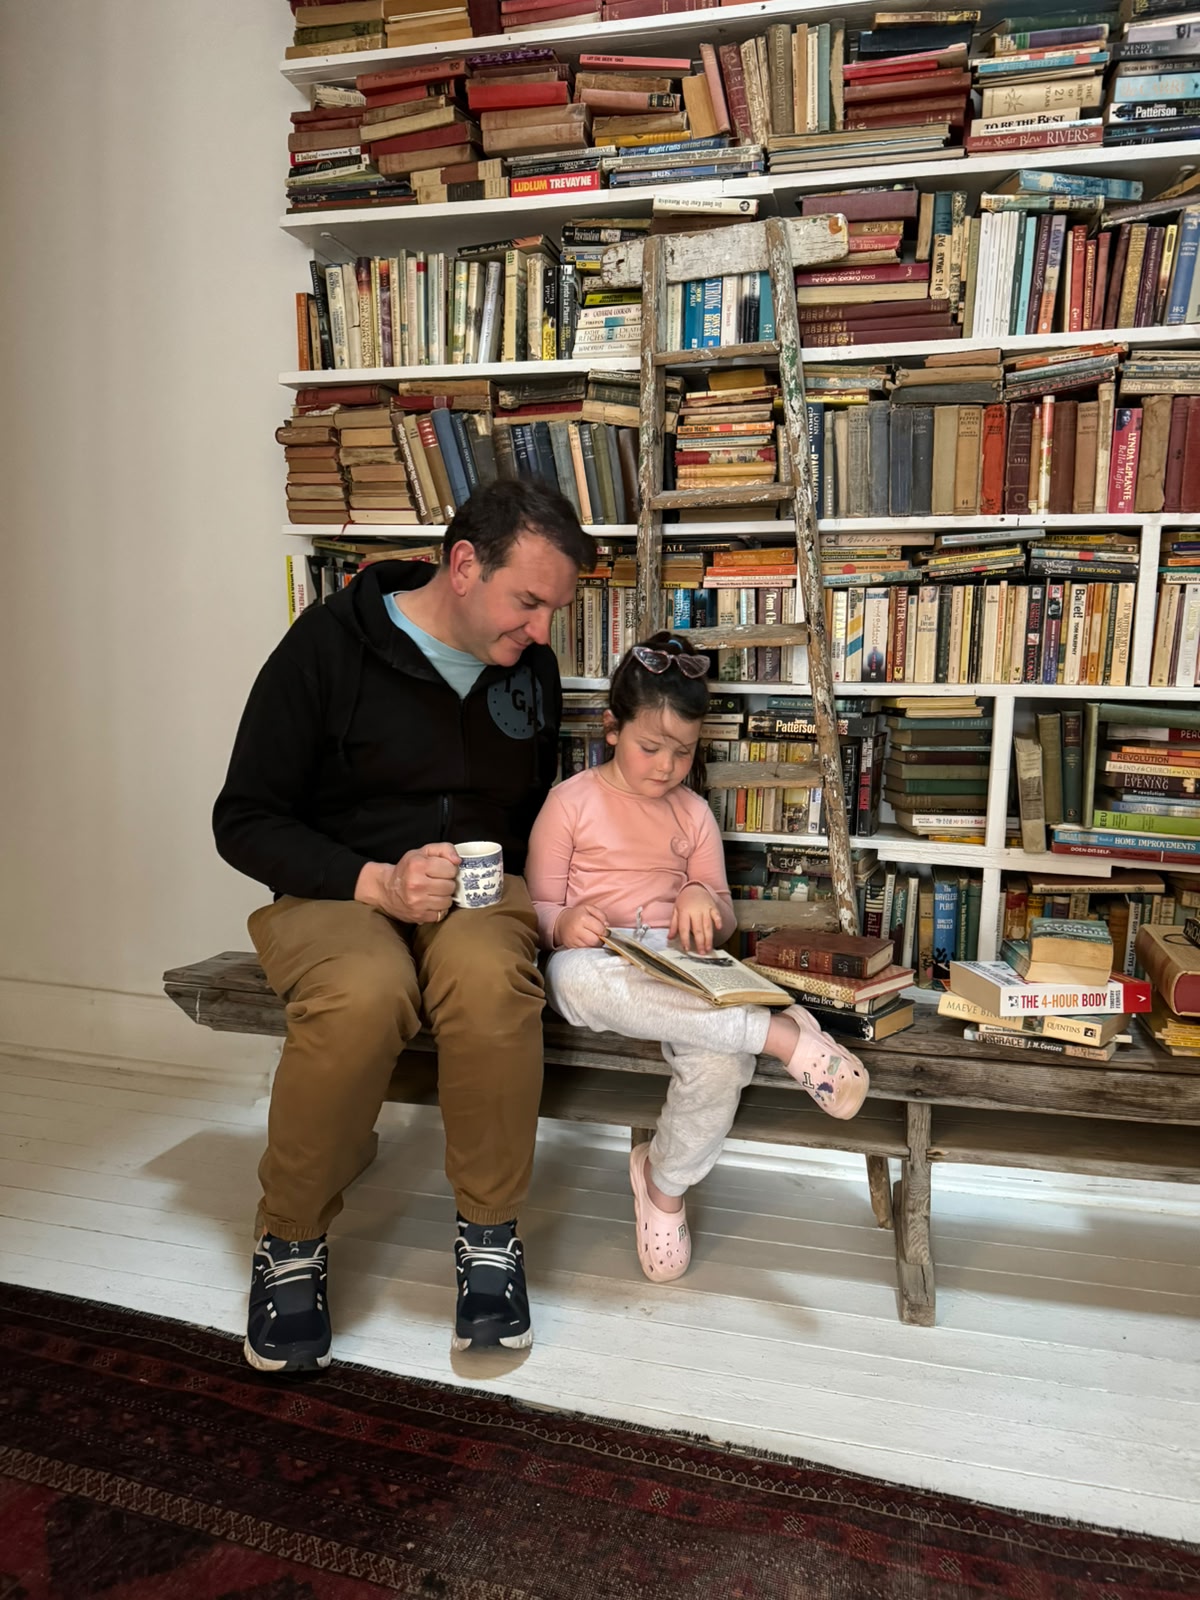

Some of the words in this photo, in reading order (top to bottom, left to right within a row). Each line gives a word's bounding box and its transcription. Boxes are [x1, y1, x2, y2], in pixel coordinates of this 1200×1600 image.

[1120, 48, 1153, 56] WALLACE
[1124, 43, 1151, 51] WENDY
[1055, 88, 1064, 102] 21
[1135, 106, 1177, 118] Patterson
[1016, 119, 1036, 127] THE
[1037, 114, 1065, 124] BEST
[1019, 132, 1042, 145] Blew
[1047, 129, 1089, 144] RIVERS
[648, 143, 664, 153] Night
[514, 179, 547, 193] LUDLUM
[550, 176, 592, 189] TREVAYNE
[936, 252, 946, 274] SWAAR
[705, 278, 721, 309] STRONG
[578, 334, 604, 342] REICHS
[1128, 433, 1137, 460] LYNDA
[1118, 444, 1127, 465] Bella
[1115, 466, 1124, 489] Mafia
[1123, 461, 1134, 501] LaPLANTE
[612, 588, 620, 618] JONATHAN
[766, 592, 777, 610] Tom
[898, 590, 907, 621] HEYER
[612, 619, 620, 654] KELLERMAN
[1117, 753, 1169, 764] REVOLUTION
[1123, 764, 1136, 772] END
[1124, 777, 1169, 790] EVENING
[1115, 838, 1137, 846] HOME
[1138, 839, 1197, 851] IMPROVEMENTS
[1036, 926, 1108, 936] SEYMOUR
[802, 994, 820, 1004] Anita
[821, 996, 854, 1009] Broner
[946, 1001, 978, 1014] MAEVE
[1021, 995, 1039, 1009] THE
[1041, 994, 1078, 1008] 4-HOUR
[1082, 993, 1107, 1007] BODY
[1047, 1022, 1081, 1034] QUENTINS
